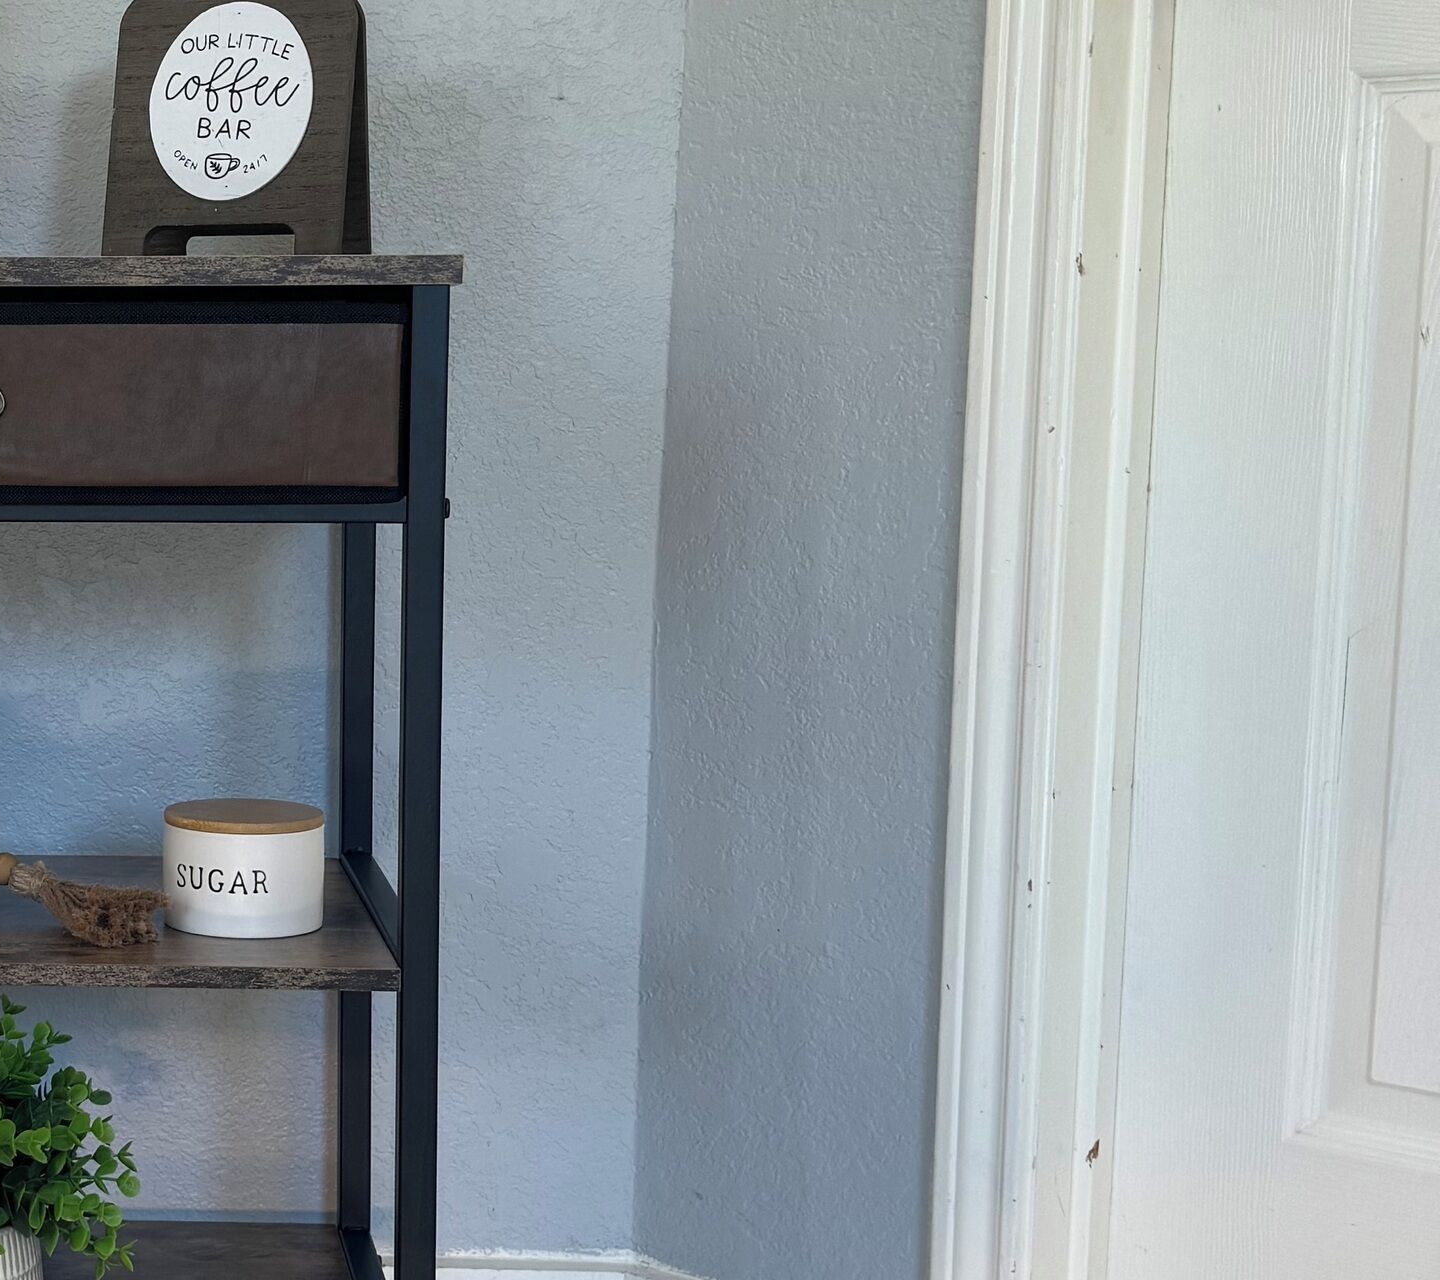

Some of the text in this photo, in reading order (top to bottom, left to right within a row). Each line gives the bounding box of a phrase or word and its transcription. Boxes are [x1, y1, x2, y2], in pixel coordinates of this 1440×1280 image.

[180, 32, 295, 61] OUR LITTLE
[165, 56, 300, 114] coffee
[196, 117, 252, 140] BAR
[173, 149, 198, 171] OPEN
[176, 863, 269, 895] SUGAR
